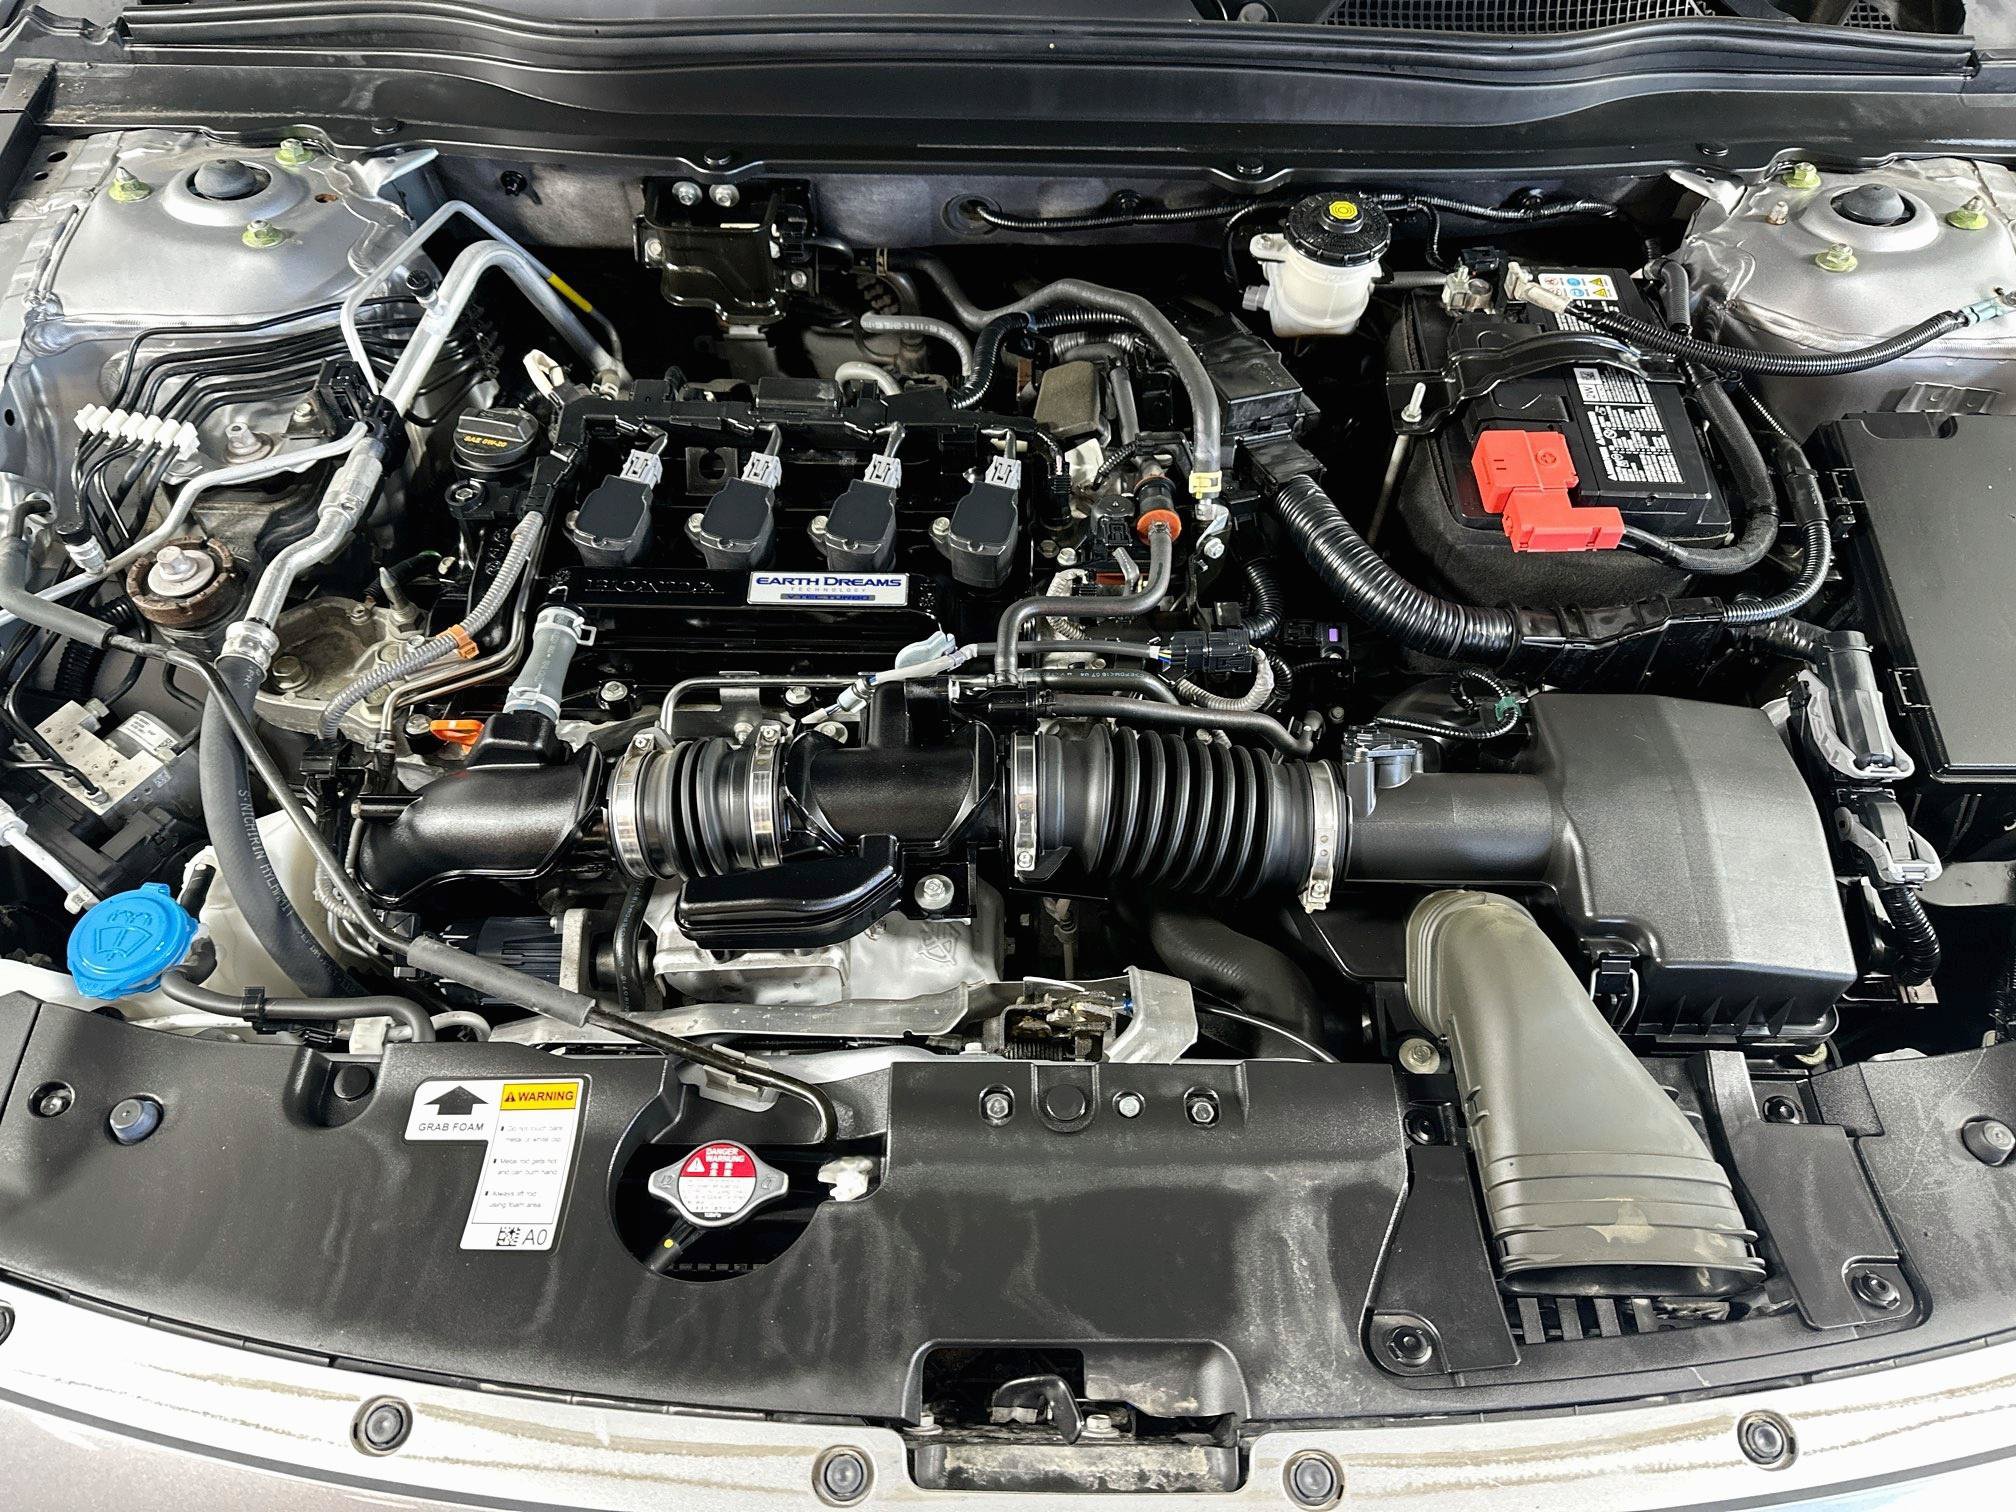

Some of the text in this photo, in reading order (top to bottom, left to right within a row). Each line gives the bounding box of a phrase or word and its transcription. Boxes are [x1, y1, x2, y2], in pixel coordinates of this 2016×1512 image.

[756, 577, 901, 587] EARTH DREAMS
[518, 1091, 574, 1101] WARNING
[418, 1122, 484, 1131] GRAB FOAM
[706, 1147, 739, 1155] DANGER
